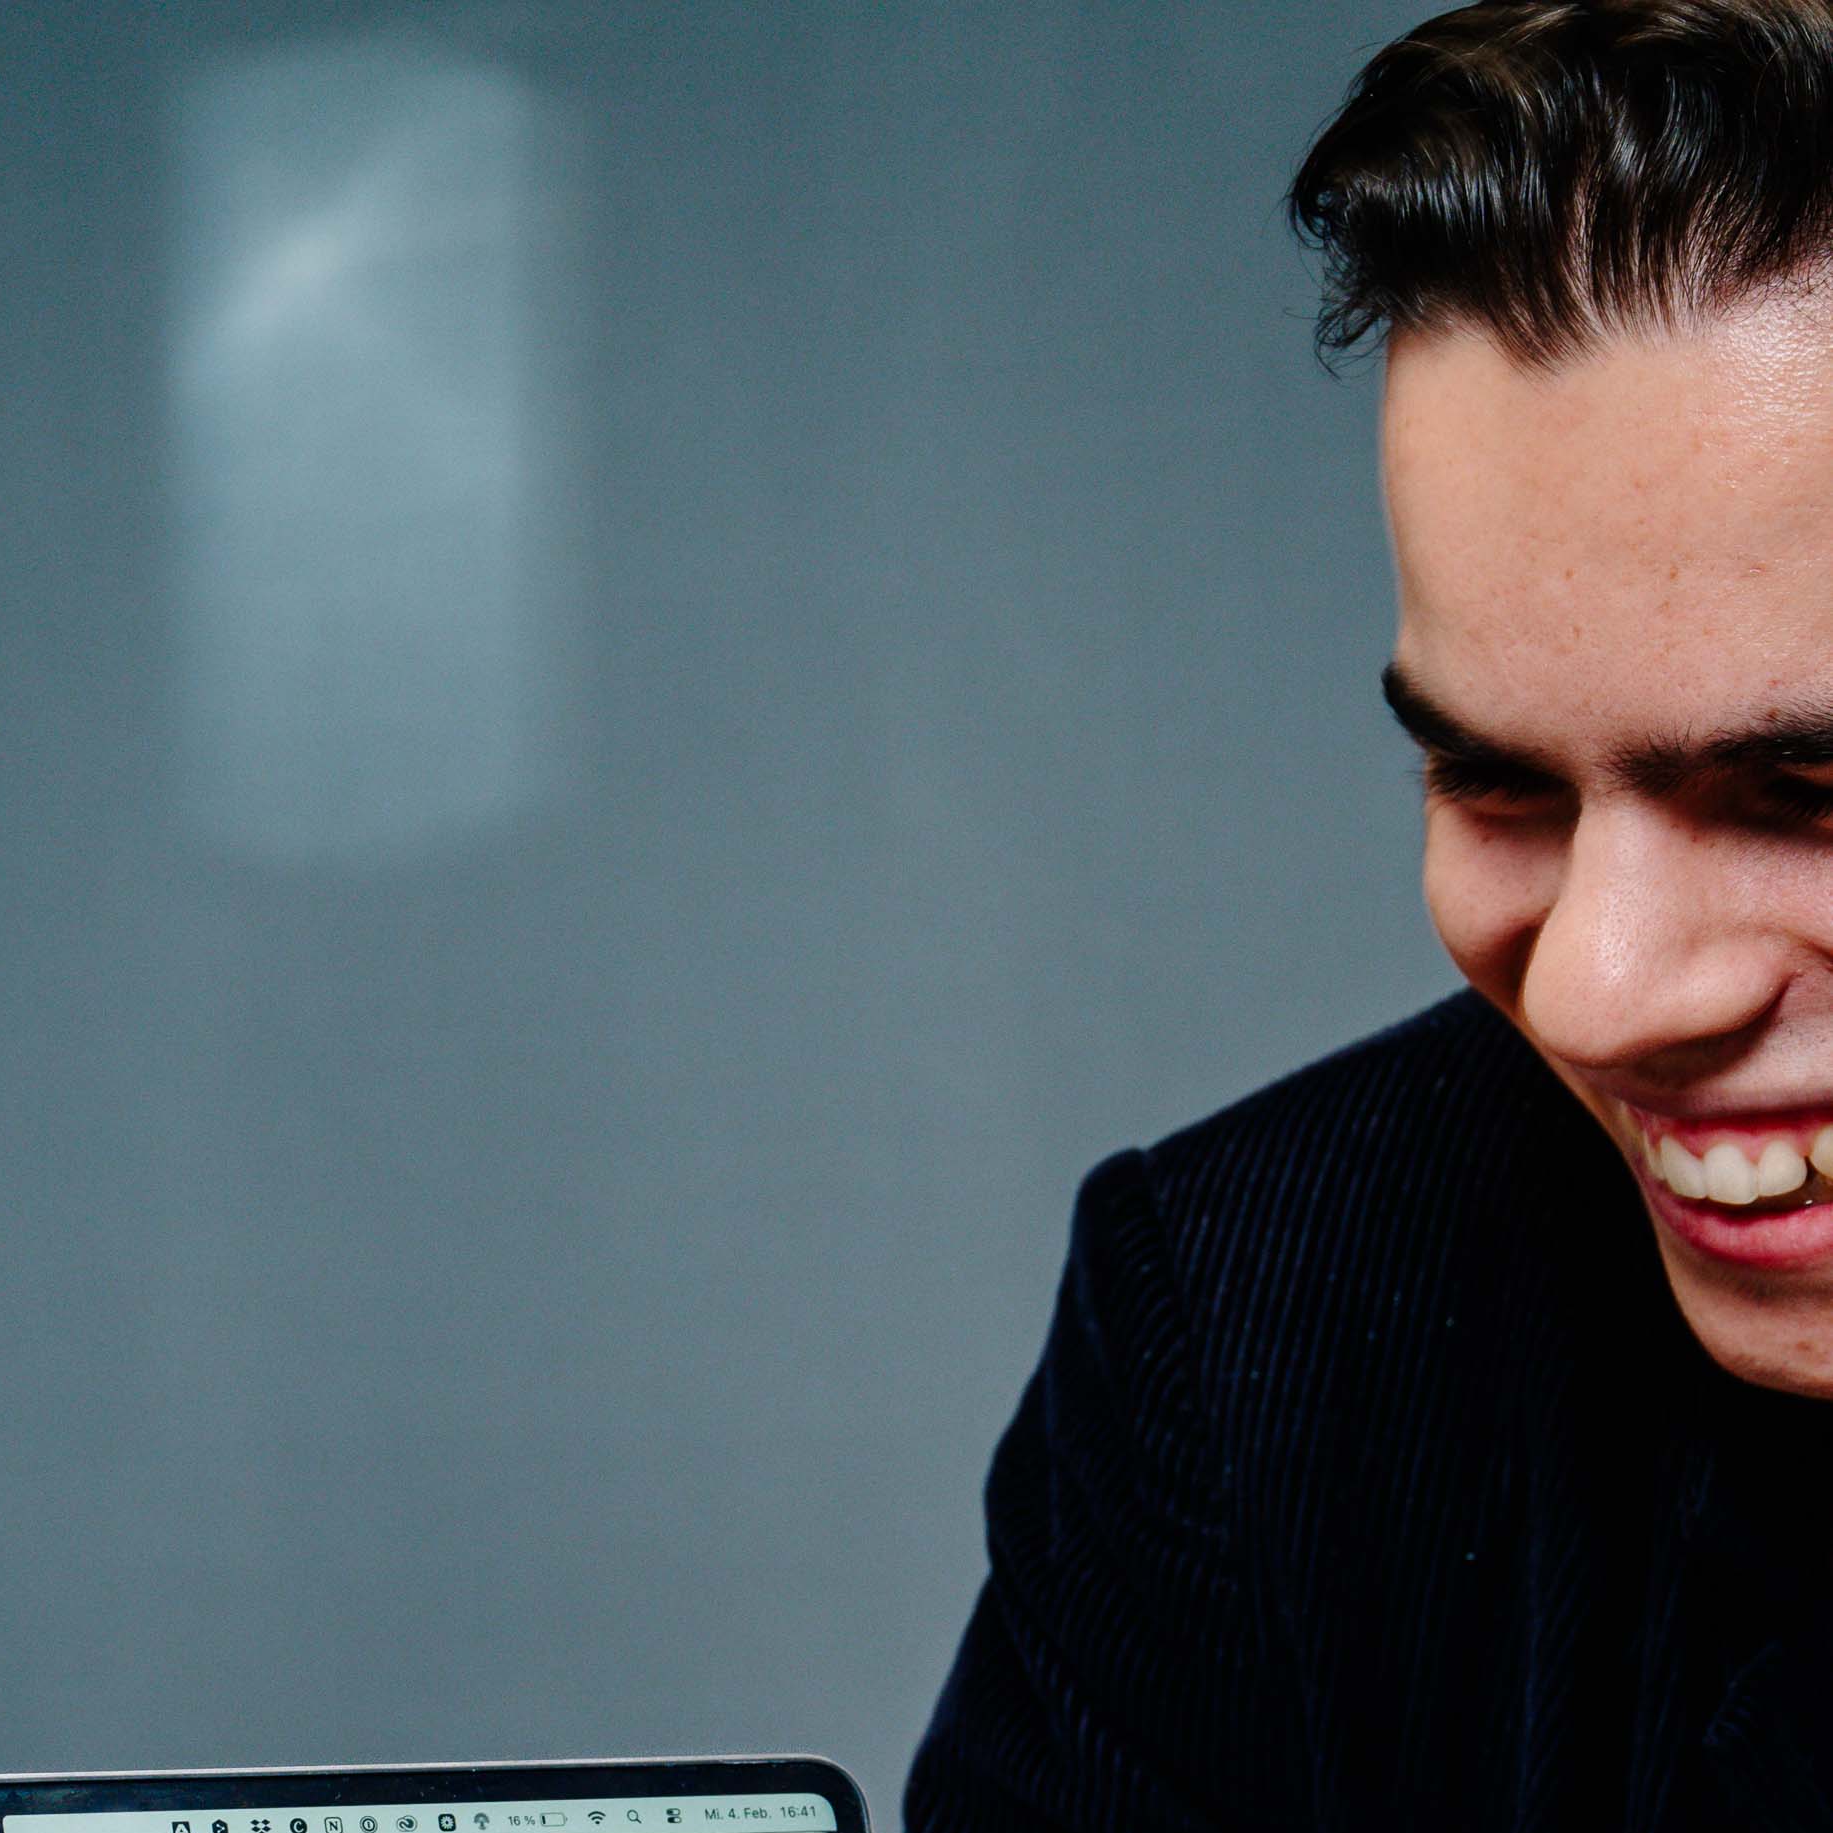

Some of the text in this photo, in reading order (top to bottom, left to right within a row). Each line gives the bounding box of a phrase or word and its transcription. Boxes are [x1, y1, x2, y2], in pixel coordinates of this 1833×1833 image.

[508, 1816, 521, 1826] 16
[524, 1816, 535, 1825] %
[728, 1808, 739, 1819] 4.
[744, 1807, 771, 1819] Feb.
[780, 1806, 816, 1818] 16:41
